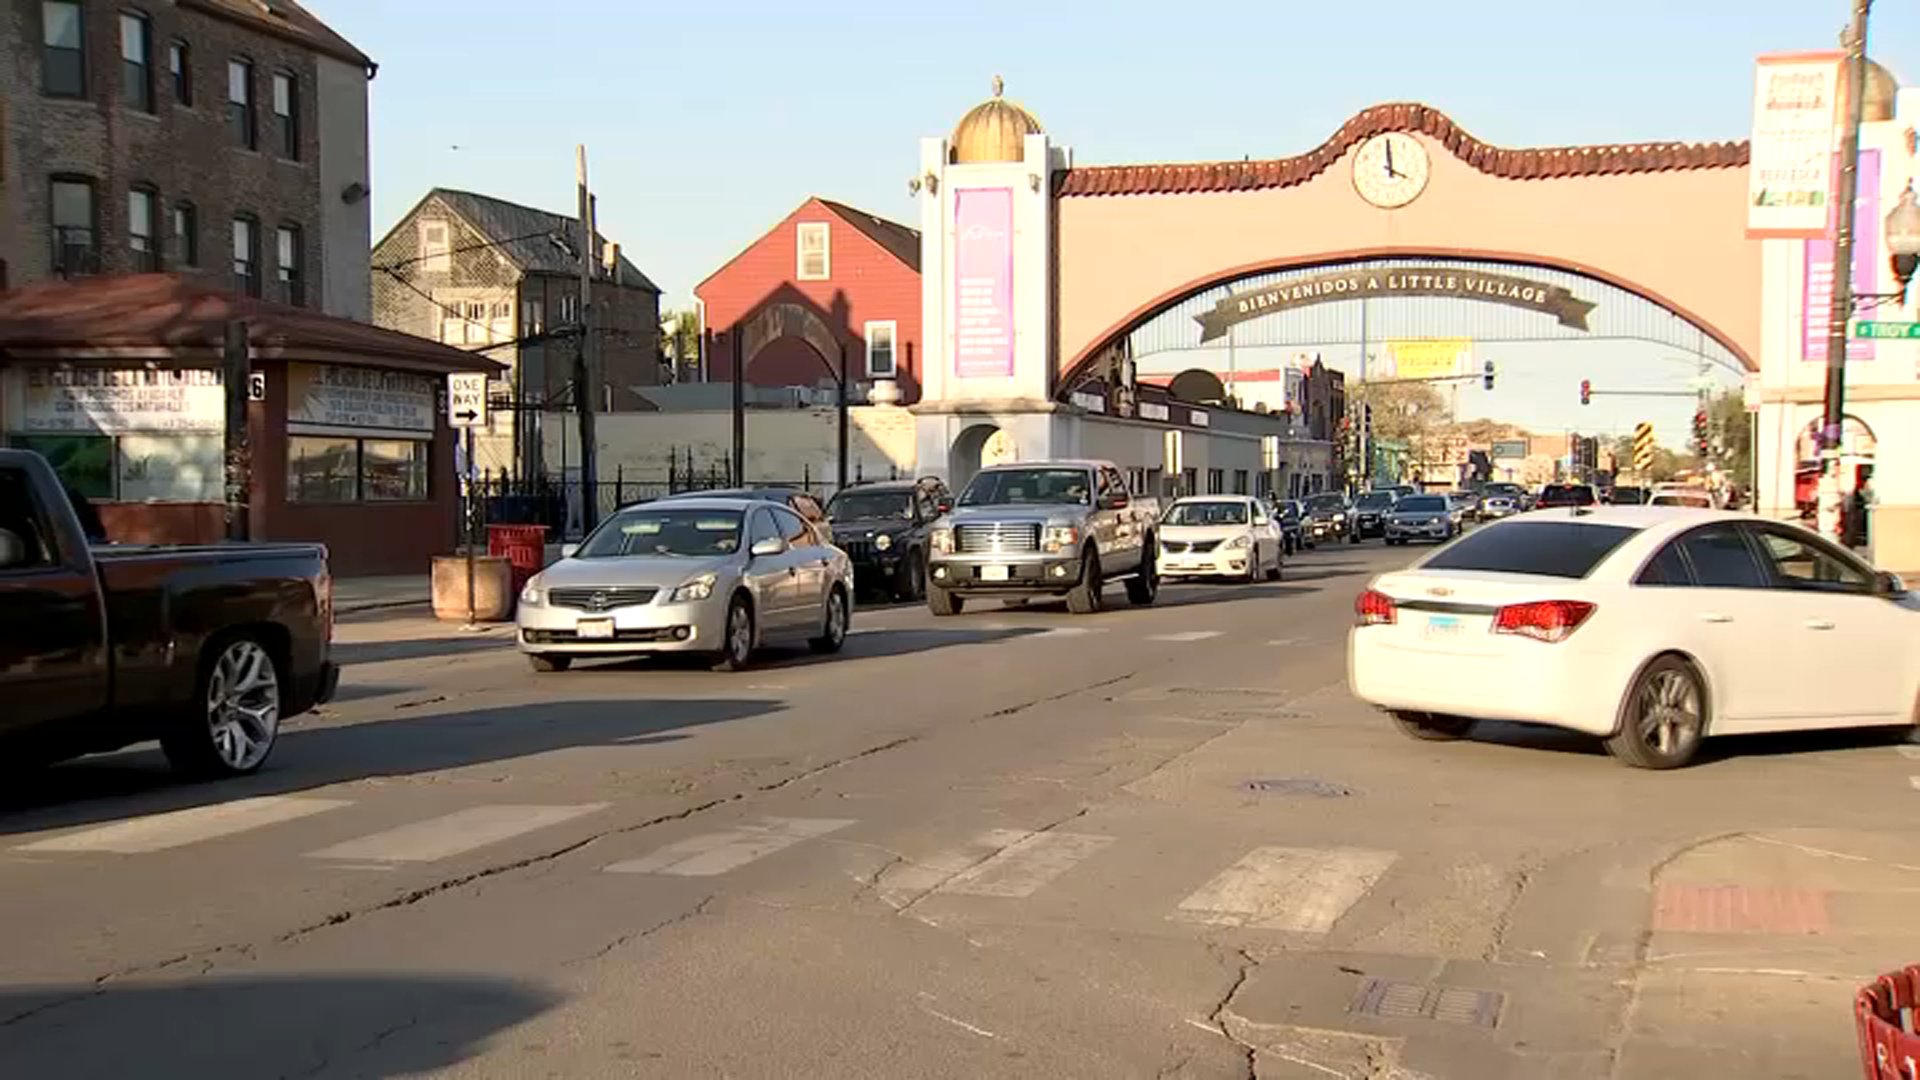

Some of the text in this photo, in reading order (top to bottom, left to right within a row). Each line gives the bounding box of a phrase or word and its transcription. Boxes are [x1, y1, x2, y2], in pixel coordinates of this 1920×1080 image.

[1238, 274, 1548, 314] BIENVENIDOS A LITTLE VILLAGE
[1871, 323, 1909, 337] TROY
[453, 379, 480, 391] ONE
[453, 393, 481, 405] WAY
